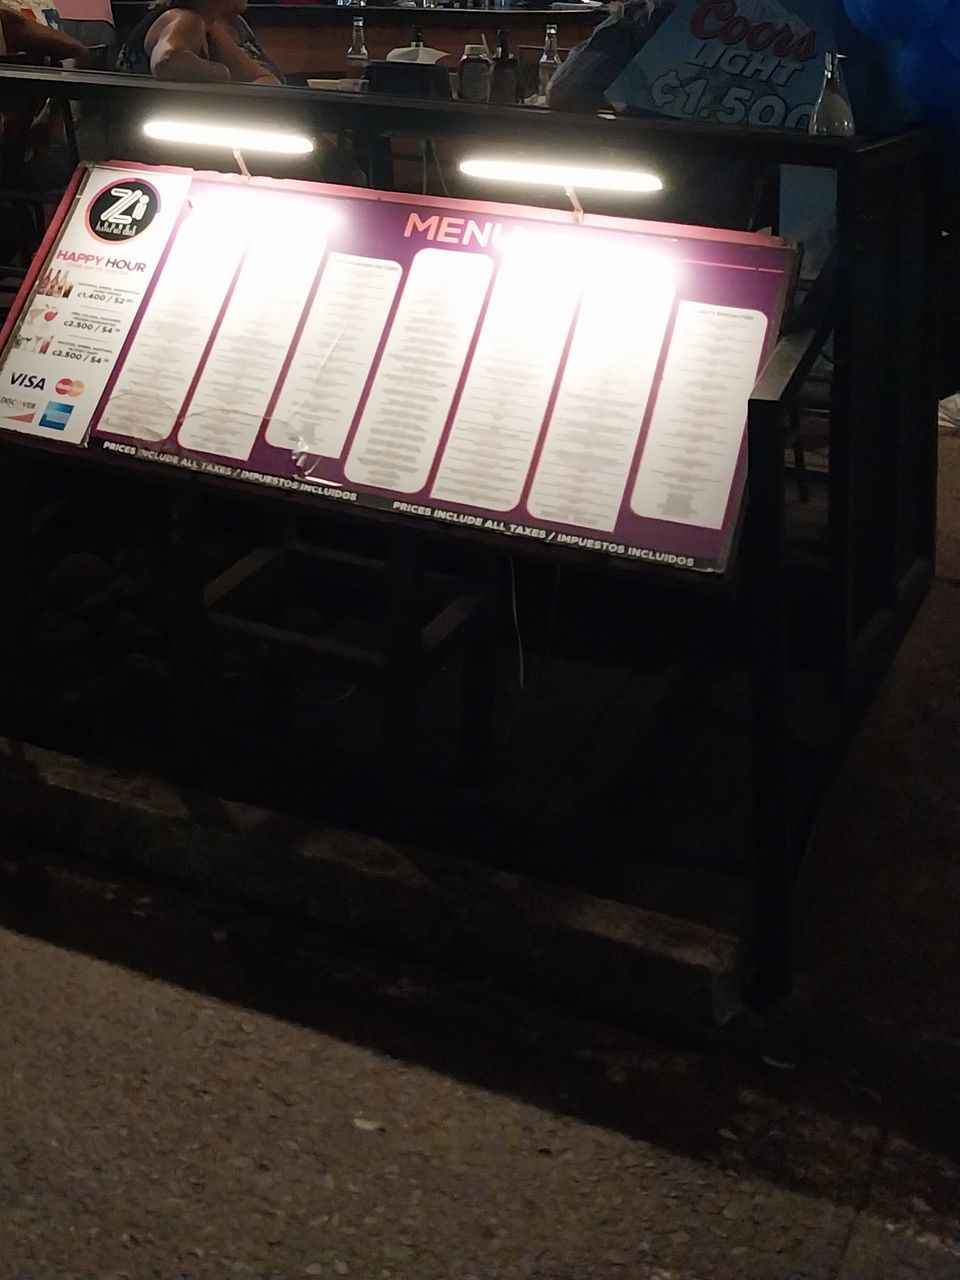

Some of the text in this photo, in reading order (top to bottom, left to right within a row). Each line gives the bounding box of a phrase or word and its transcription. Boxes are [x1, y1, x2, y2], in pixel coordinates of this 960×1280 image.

[686, 42, 806, 87] LIGHT
[56, 249, 105, 266] HAPPY
[105, 257, 147, 273] HOUR
[10, 371, 46, 391] VISA
[0, 396, 36, 410] DISCVER
[103, 440, 136, 456] PRICES
[138, 448, 178, 465] INCLUDE
[180, 457, 199, 469] ALL
[200, 461, 232, 476] TAXES
[240, 469, 299, 491] IMPUESTOS
[300, 483, 357, 502] INCLUIDOS
[393, 501, 432, 517] PRICES
[433, 509, 483, 527] INCLUDE
[484, 519, 506, 532] ALL
[508, 523, 547, 539] TAXES
[556, 533, 626, 555] IMPUESTOS
[627, 546, 695, 568] INCLUIDOS
